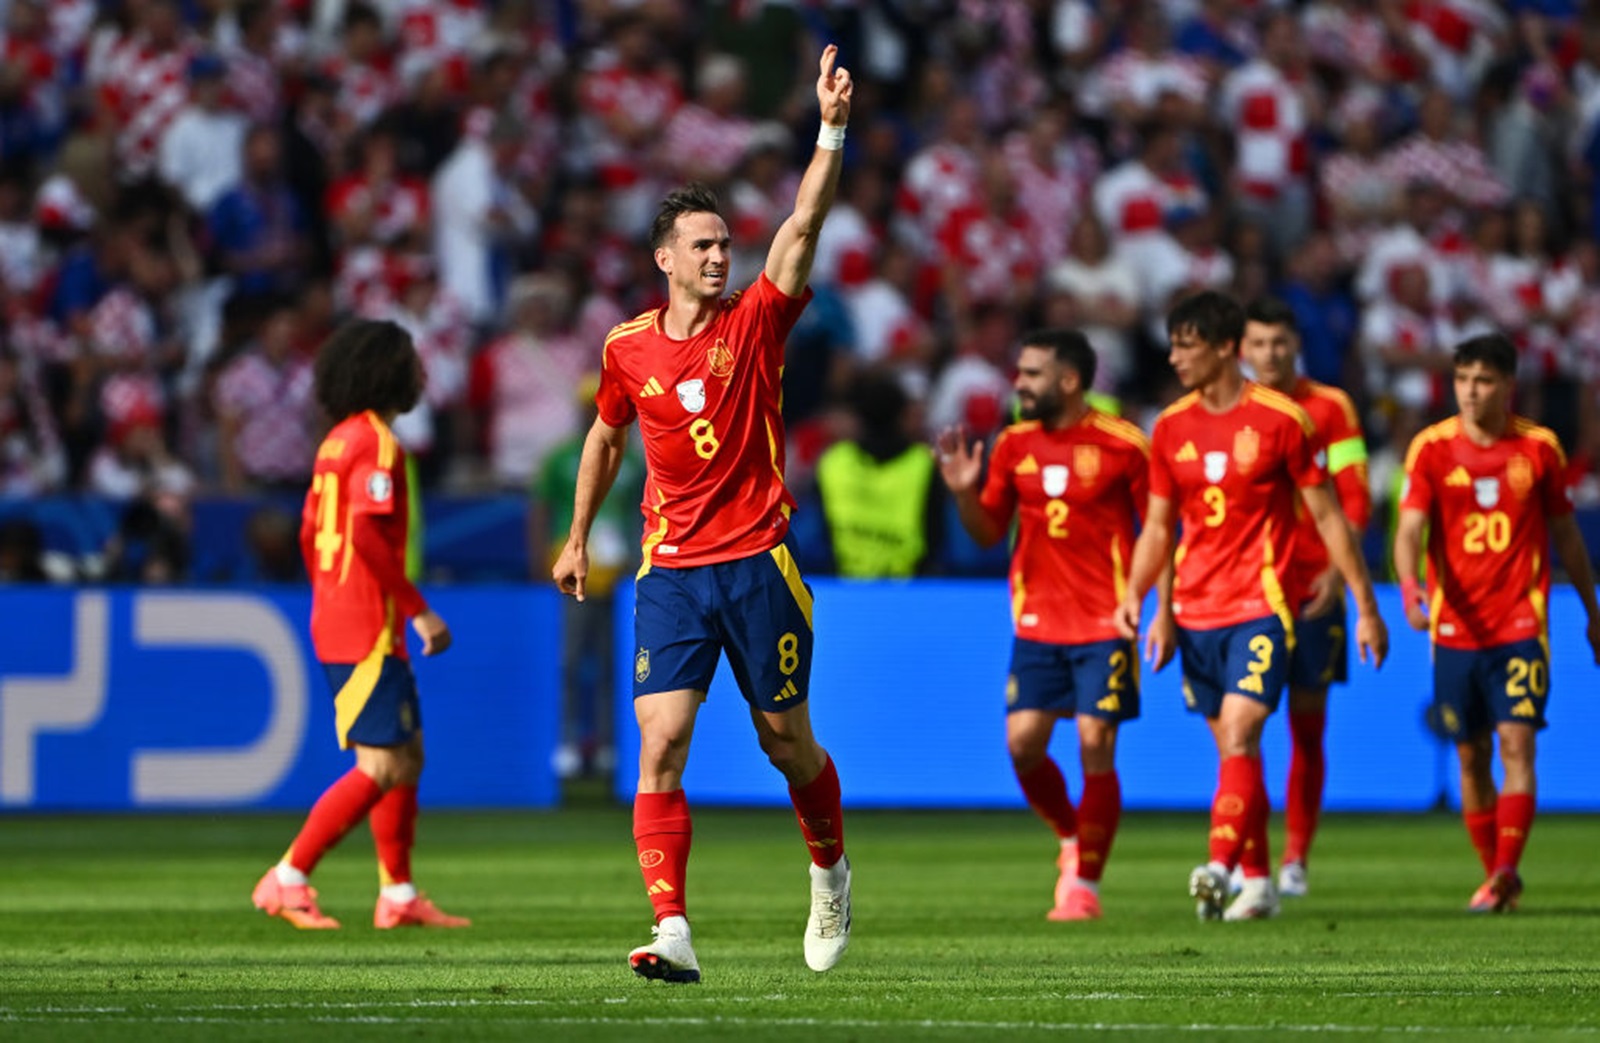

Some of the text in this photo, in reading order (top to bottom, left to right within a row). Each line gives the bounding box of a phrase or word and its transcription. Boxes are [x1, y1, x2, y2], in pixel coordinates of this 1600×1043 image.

[689, 418, 720, 460] 8
[313, 472, 343, 571] 4
[1045, 498, 1069, 538] 2
[1203, 485, 1226, 527] 3
[1463, 511, 1511, 553] 20
[778, 632, 799, 675] 8
[1108, 650, 1128, 690] 2
[1247, 634, 1273, 673] 3
[1506, 657, 1546, 697] 20
